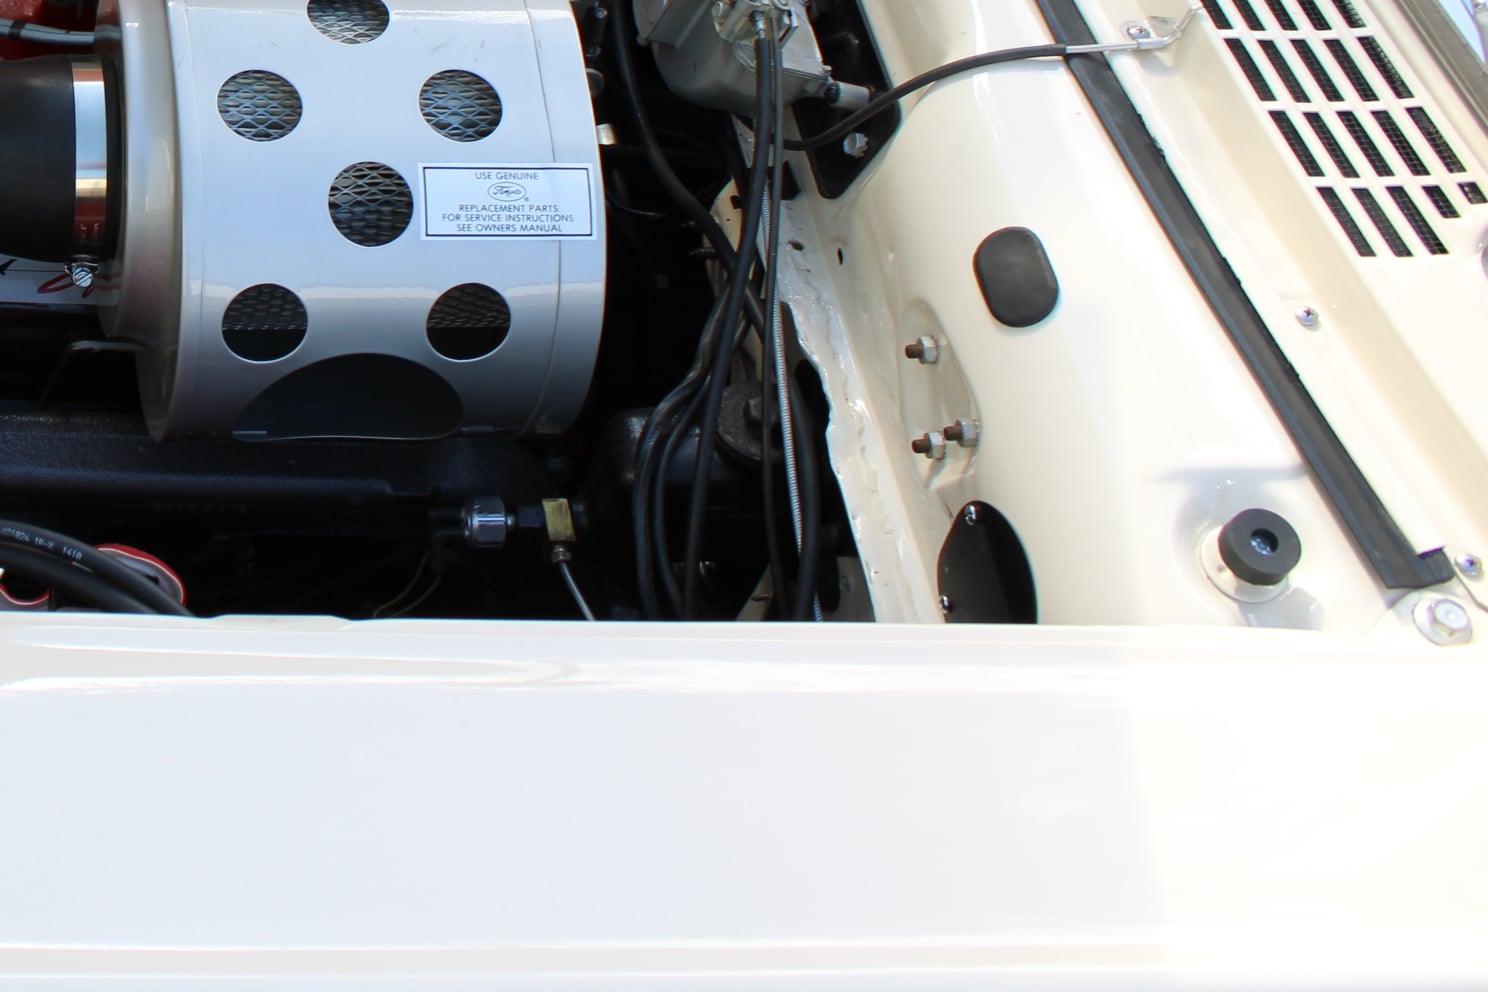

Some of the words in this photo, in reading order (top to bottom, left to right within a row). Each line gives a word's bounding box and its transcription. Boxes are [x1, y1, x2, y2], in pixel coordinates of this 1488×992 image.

[475, 172, 492, 180] USE
[496, 172, 539, 180] GENUINE
[459, 204, 525, 212] REPLACEMENT
[529, 204, 558, 213] PARTS
[442, 214, 461, 222] FOR
[465, 214, 501, 222] SERVICE
[505, 214, 574, 222] INSTRUCTIONS
[456, 224, 472, 232] SEE
[476, 224, 516, 232] OWNERS
[520, 224, 562, 232] MANUAL
